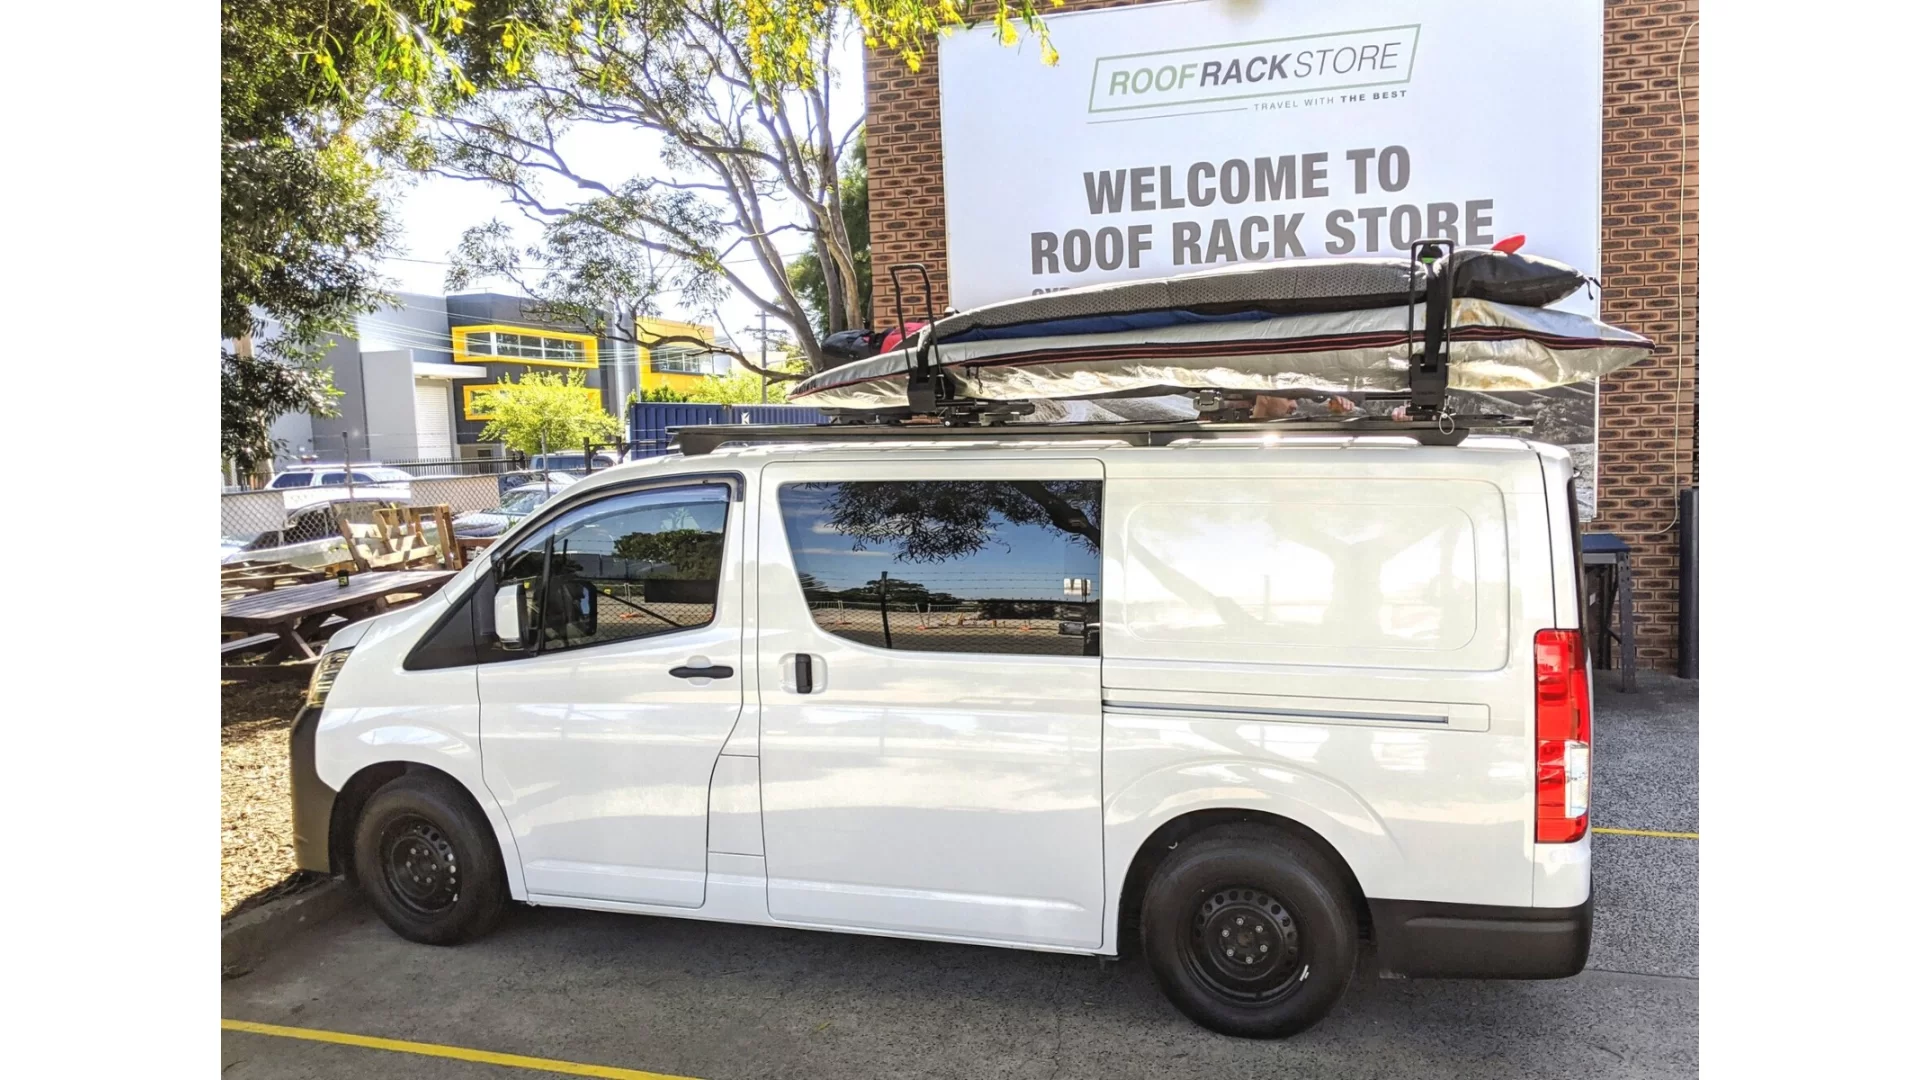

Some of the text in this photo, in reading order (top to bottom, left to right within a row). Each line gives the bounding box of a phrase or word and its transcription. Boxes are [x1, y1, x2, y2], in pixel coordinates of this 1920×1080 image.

[1254, 90, 1407, 111] TRAVEL WITH THE BEST
[1083, 145, 1410, 215] WELCOME TO
[1031, 198, 1494, 275] ROOF RACK STORE
